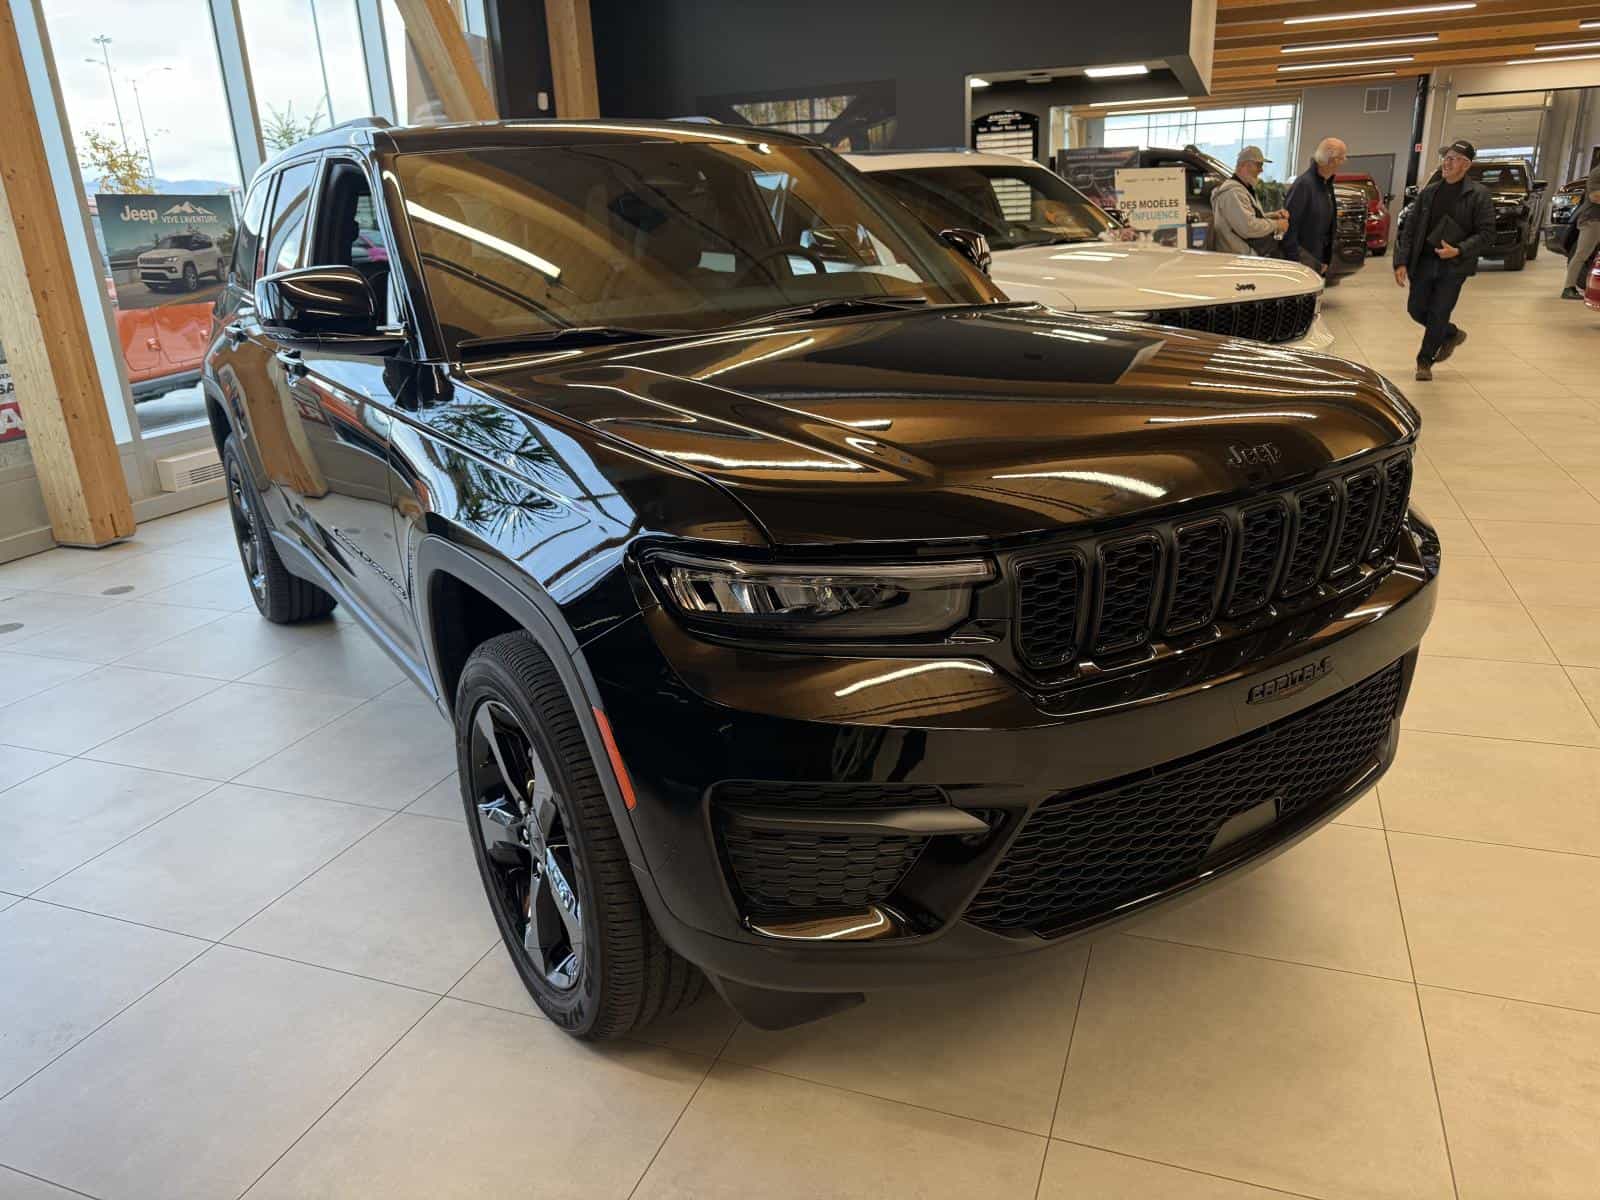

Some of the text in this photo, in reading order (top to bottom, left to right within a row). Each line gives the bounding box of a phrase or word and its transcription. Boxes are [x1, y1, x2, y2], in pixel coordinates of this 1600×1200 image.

[1120, 199, 1138, 210] DES
[120, 205, 159, 224] Jeep
[1226, 441, 1283, 467] Jeep
